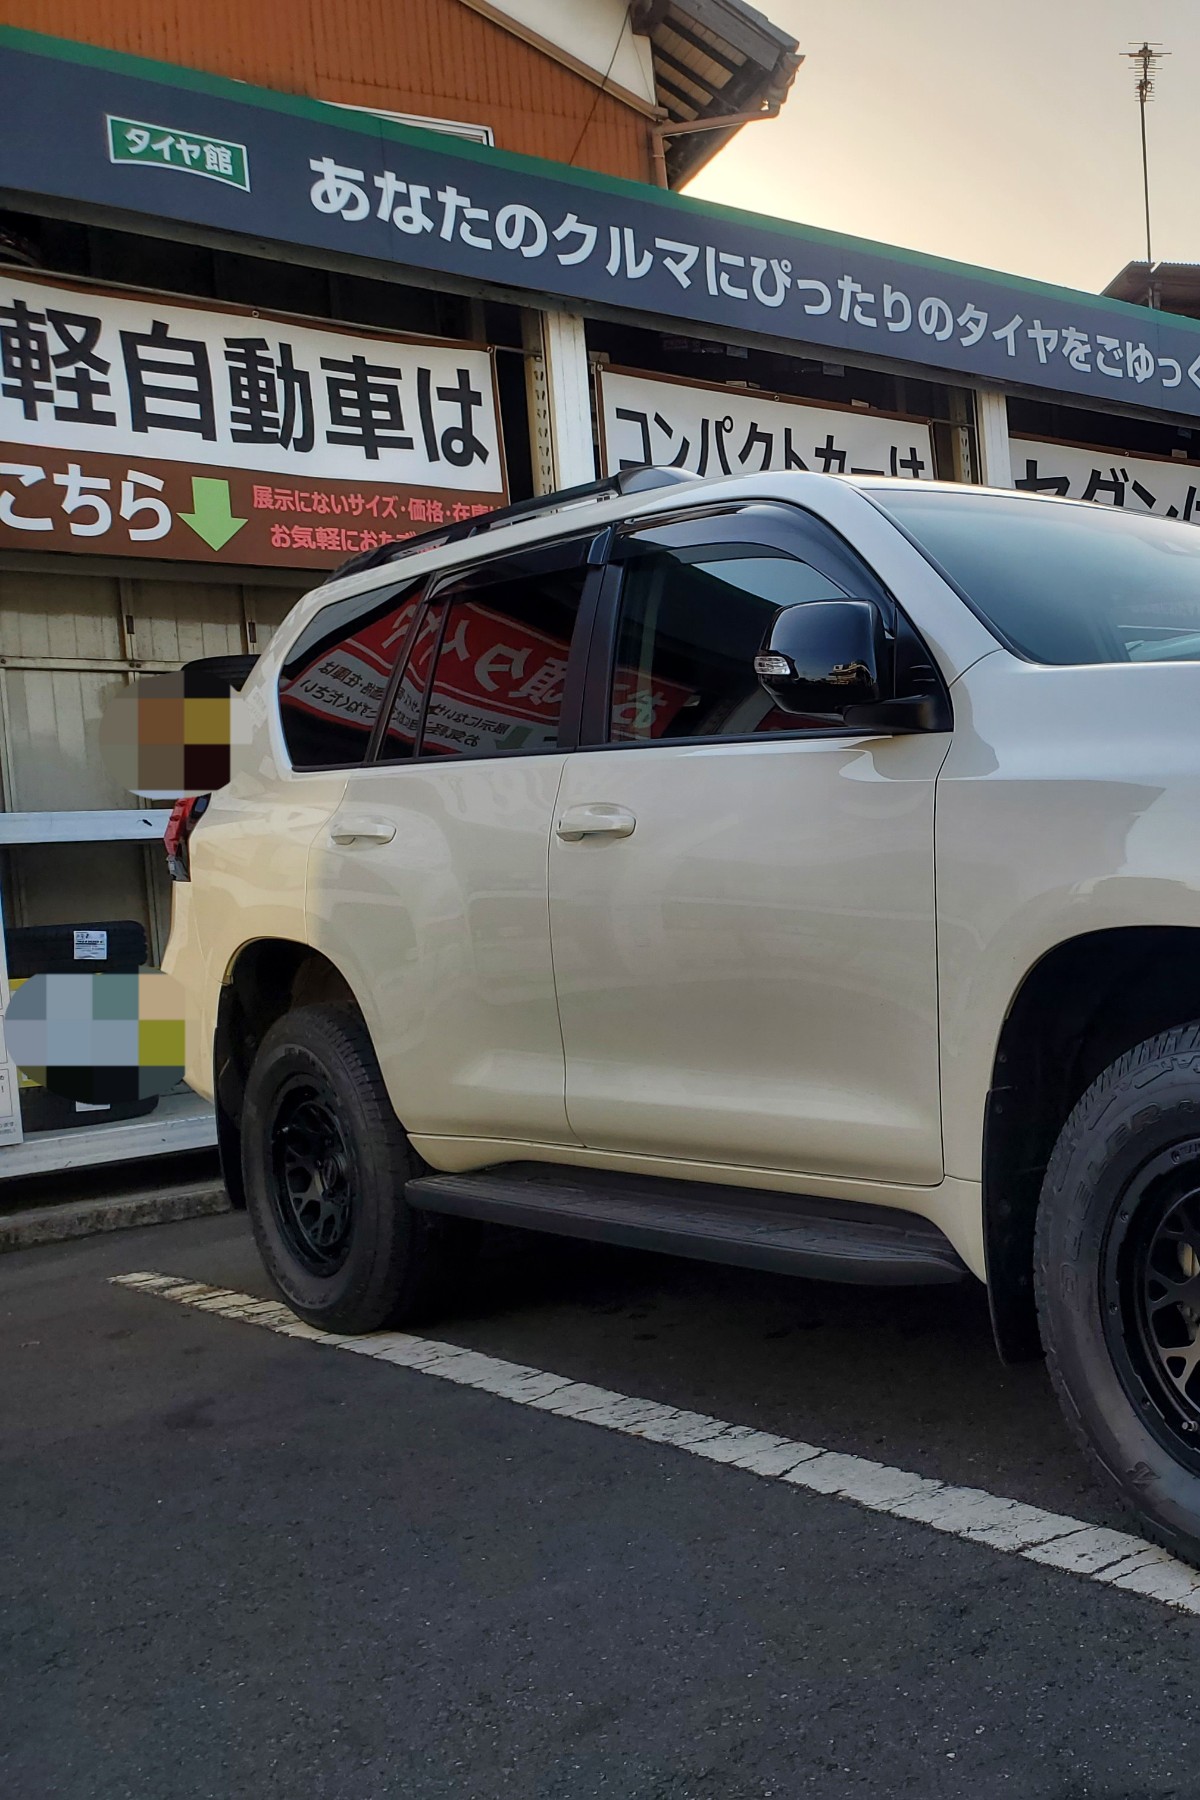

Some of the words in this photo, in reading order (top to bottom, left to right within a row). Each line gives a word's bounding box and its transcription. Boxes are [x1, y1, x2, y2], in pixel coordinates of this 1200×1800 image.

[124, 127, 233, 176] タイヤ館
[0, 299, 490, 468] 軽自動車は
[0, 461, 174, 542] こちら
[252, 484, 502, 524] 展示にないサイズ・価格・在庫
